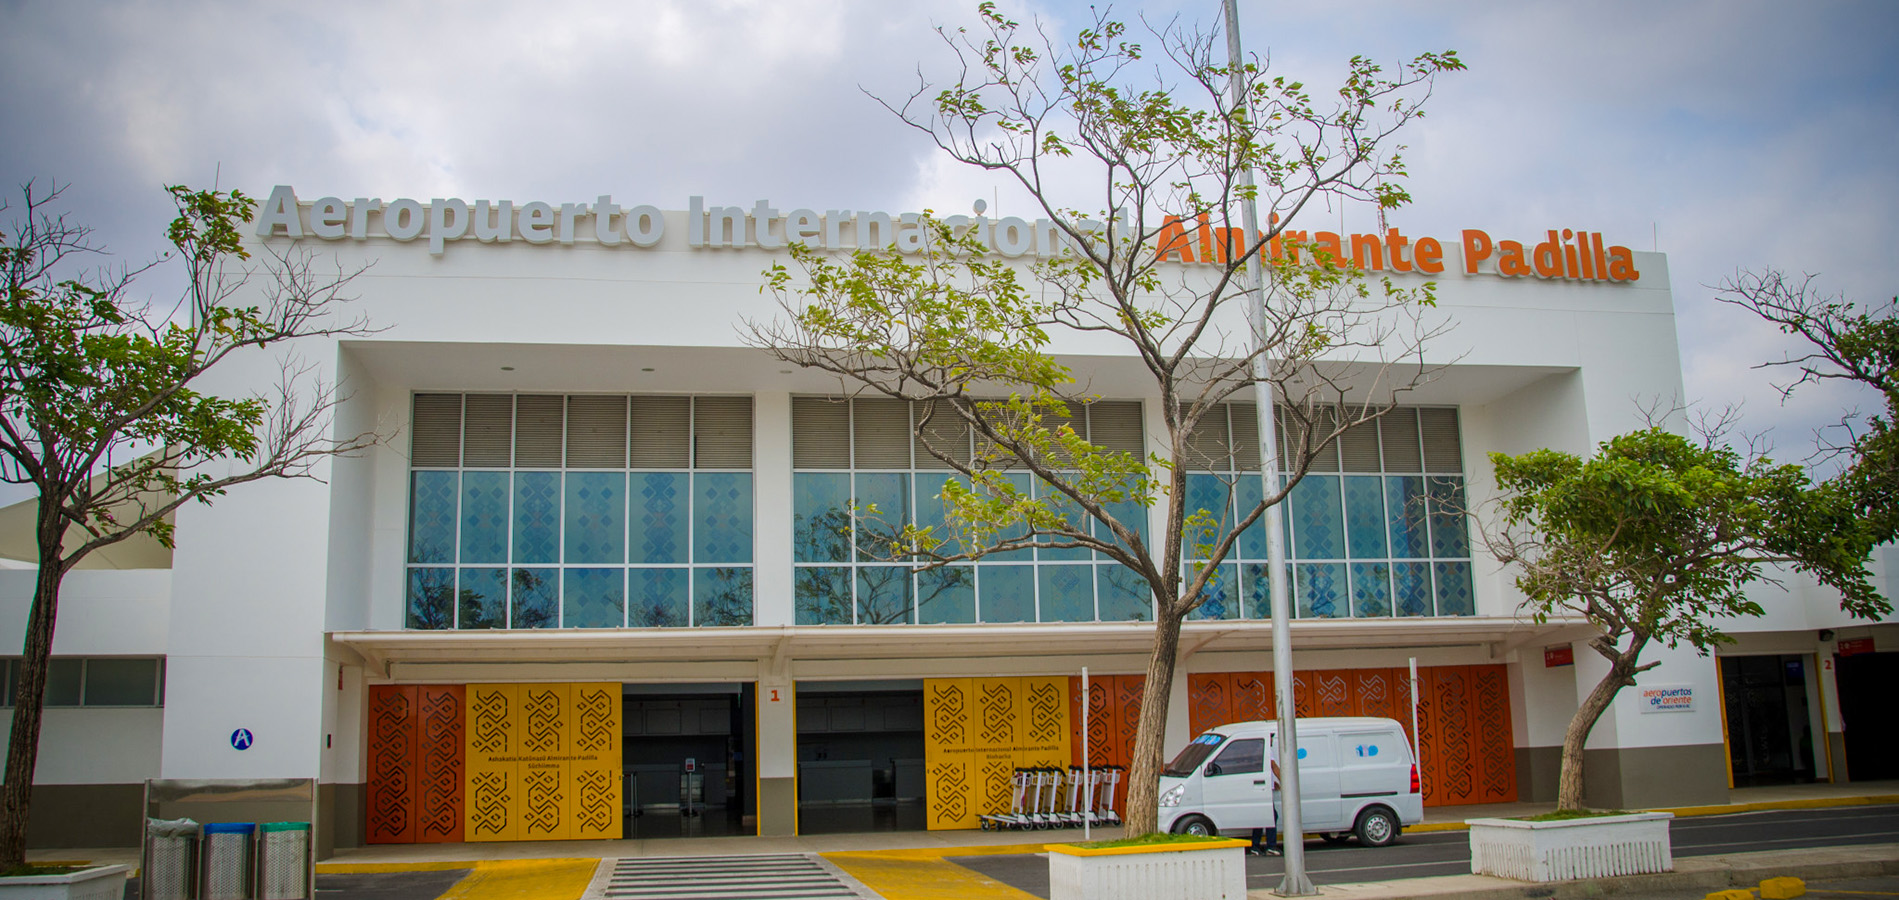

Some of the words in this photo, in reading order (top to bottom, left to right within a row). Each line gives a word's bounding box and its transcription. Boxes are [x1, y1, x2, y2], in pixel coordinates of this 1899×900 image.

[256, 185, 665, 256] Aeropuerto
[689, 195, 1129, 259] Internacional
[1155, 212, 1444, 274] Almirante
[1460, 228, 1640, 282] Padilla
[1824, 659, 1832, 670] 2
[771, 689, 780, 702] 1
[1643, 688, 1692, 698] aeropuertos
[1650, 696, 1661, 705] de
[1662, 696, 1692, 704] oriente
